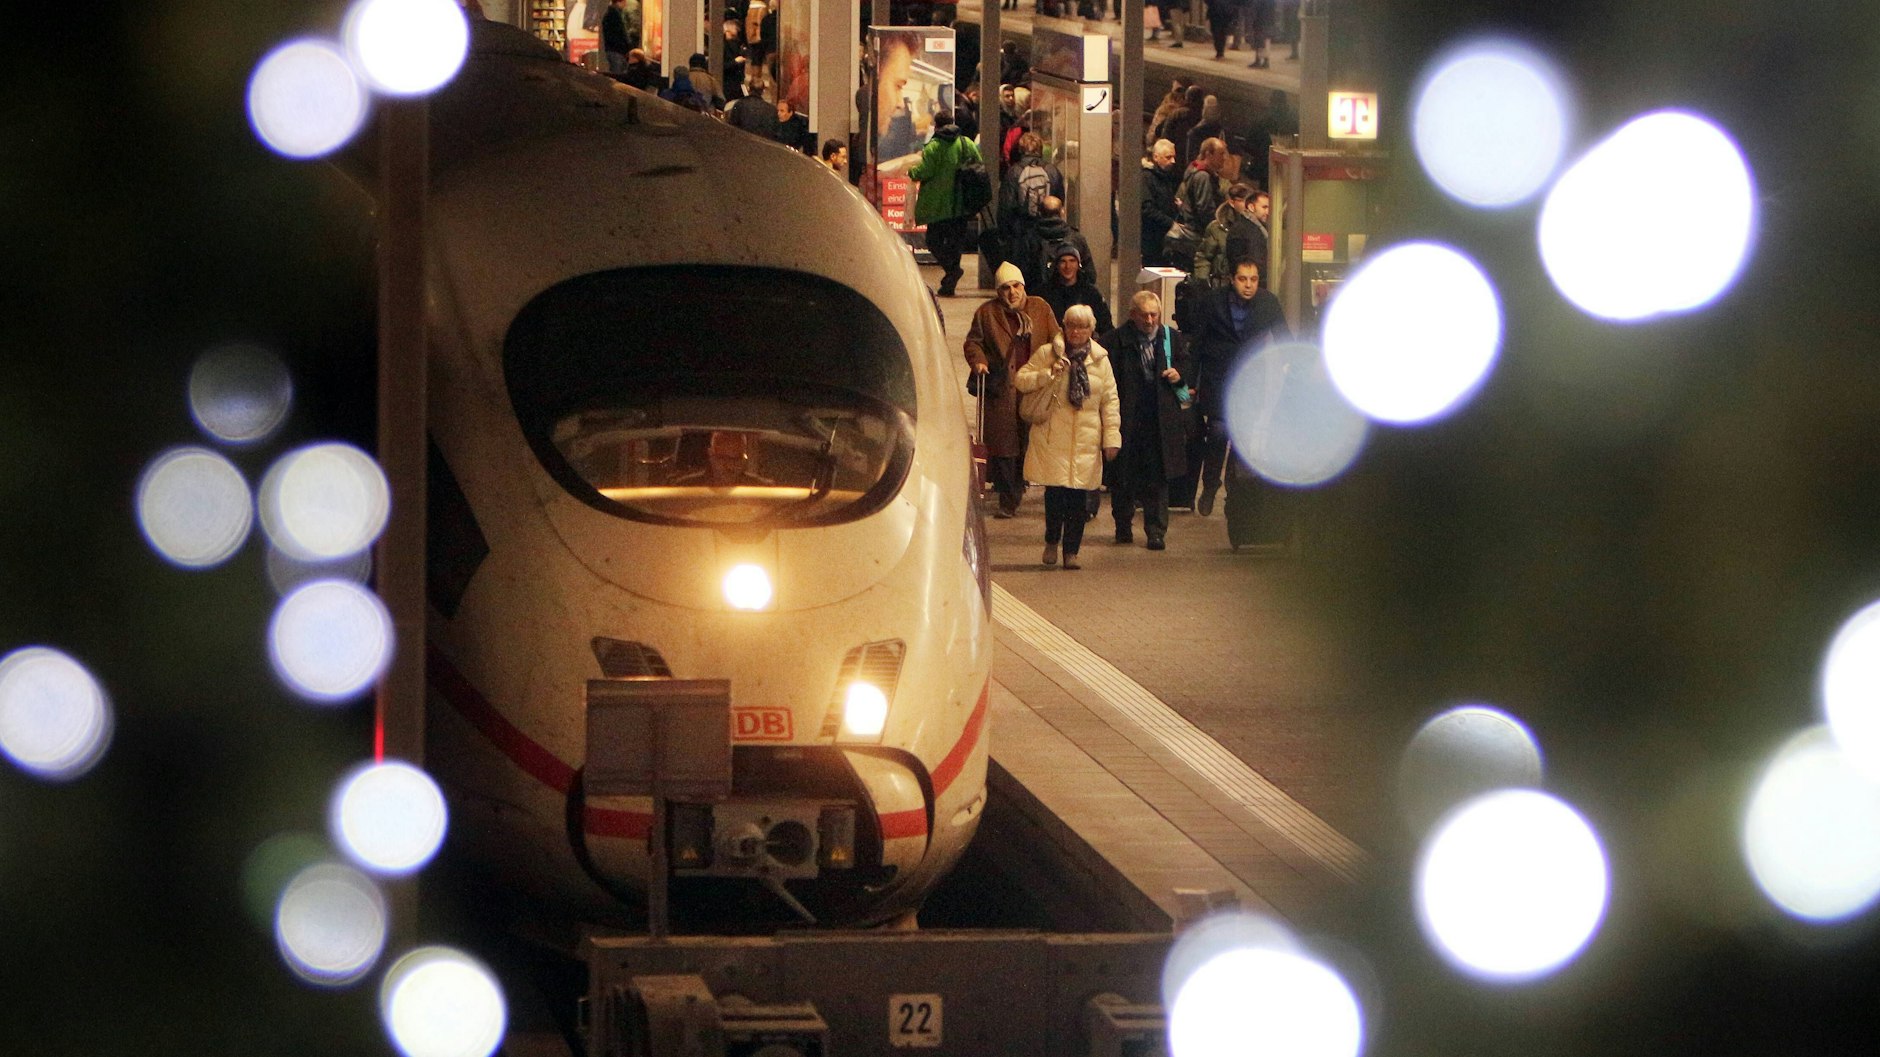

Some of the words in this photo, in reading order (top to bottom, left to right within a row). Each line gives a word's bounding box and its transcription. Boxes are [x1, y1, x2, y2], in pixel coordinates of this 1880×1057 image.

[1340, 97, 1369, 135] T
[887, 181, 907, 190] Einst
[737, 712, 786, 735] DB
[899, 1002, 932, 1034] 22
